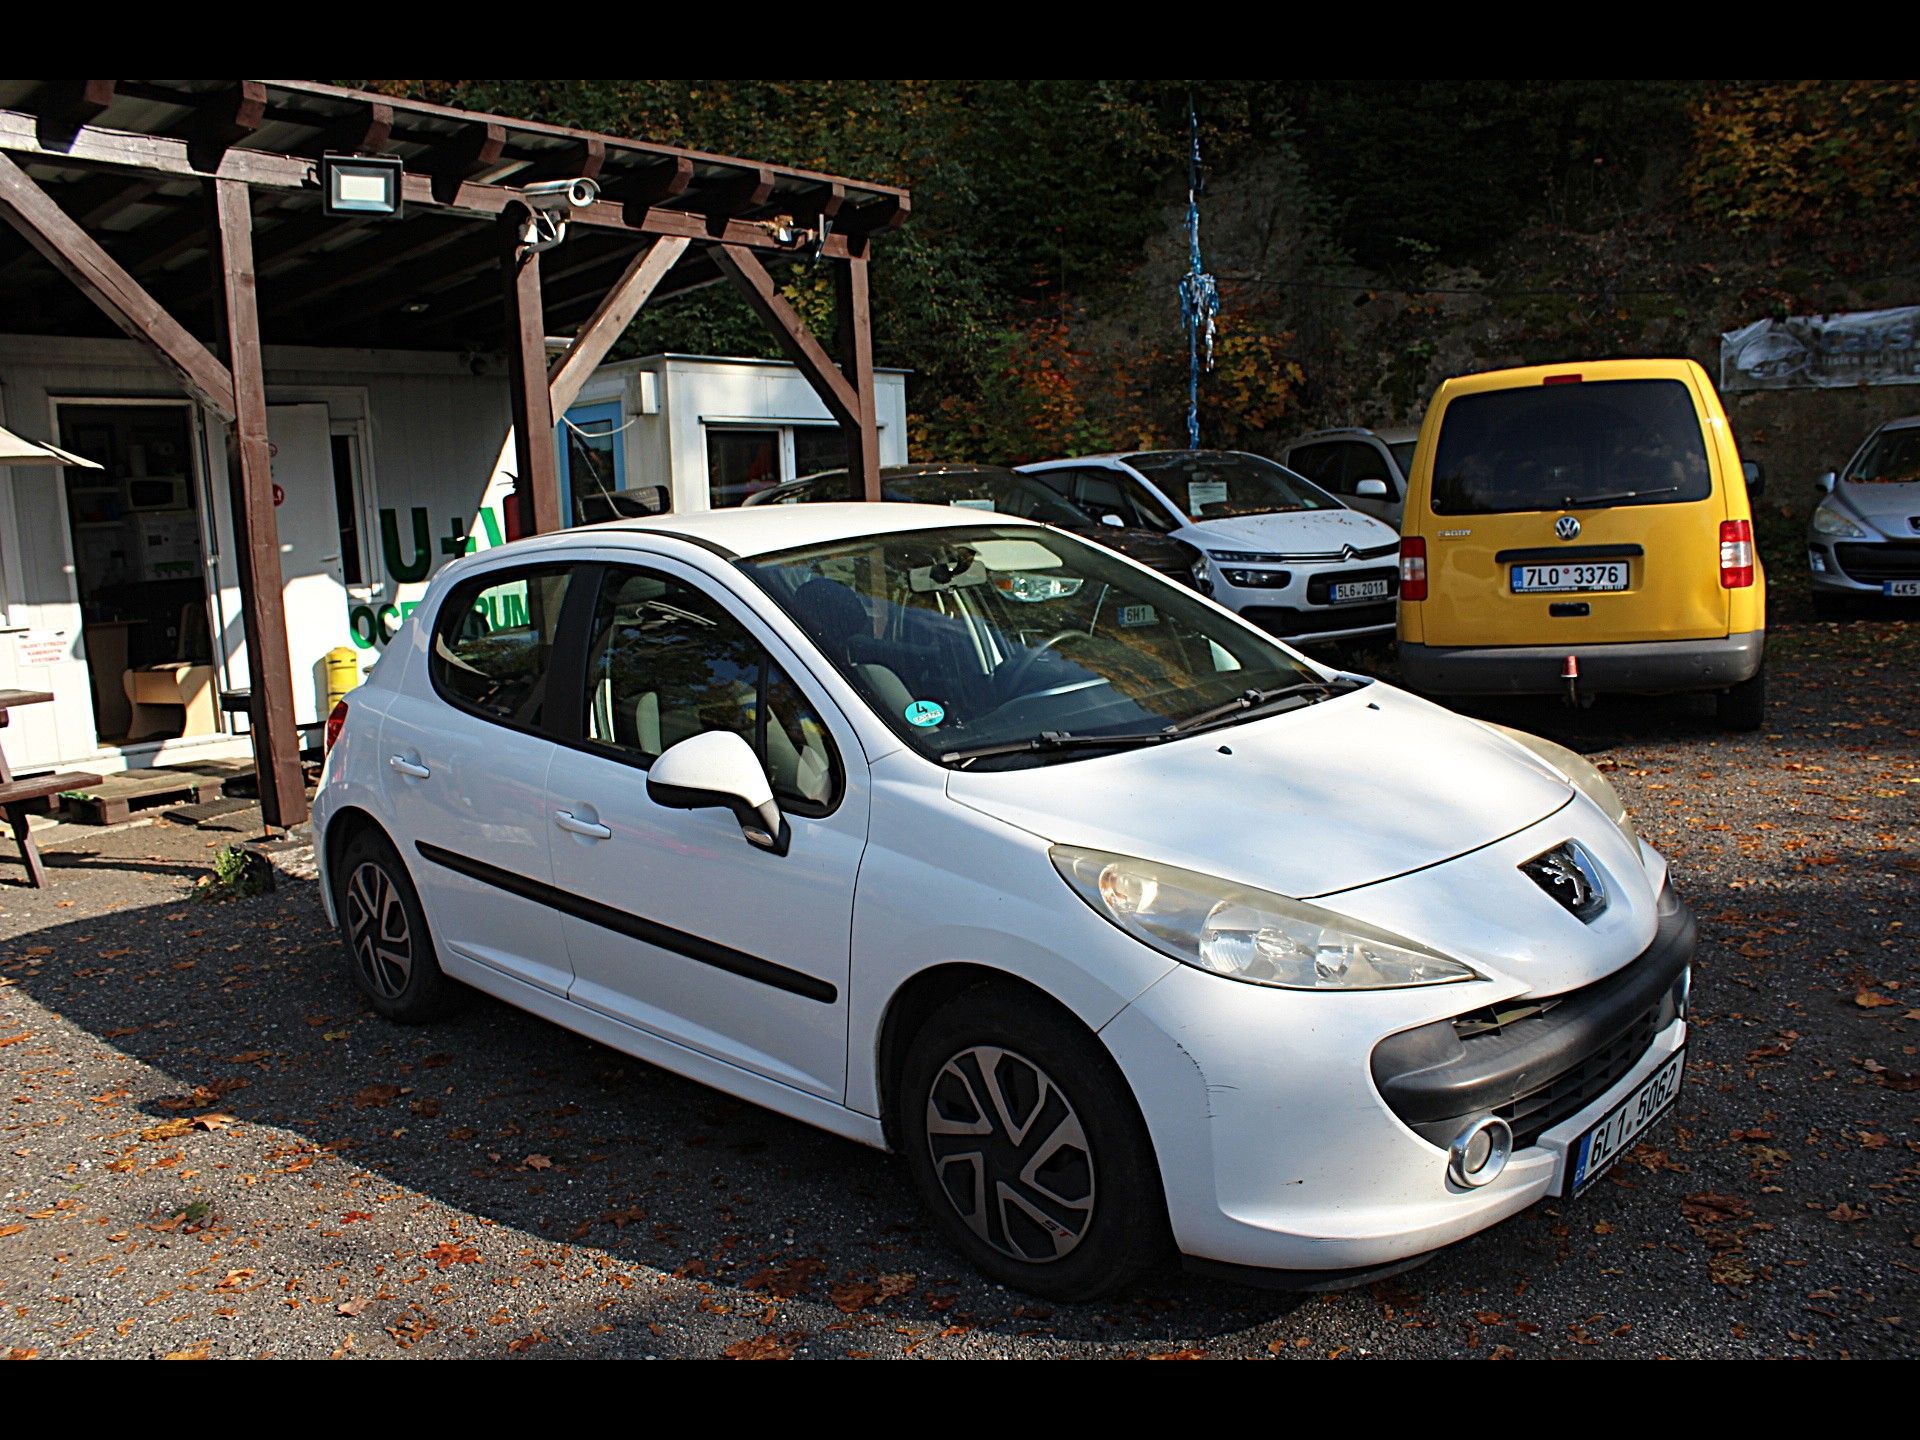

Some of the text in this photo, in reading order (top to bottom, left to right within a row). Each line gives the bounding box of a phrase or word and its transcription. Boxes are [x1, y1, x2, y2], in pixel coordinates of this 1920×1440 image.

[1573, 566, 1619, 584] 3376
[1337, 581, 1384, 598] 5L6 2011
[1590, 1106, 1627, 1168] 6L1
[1636, 1062, 1677, 1127] 5062
